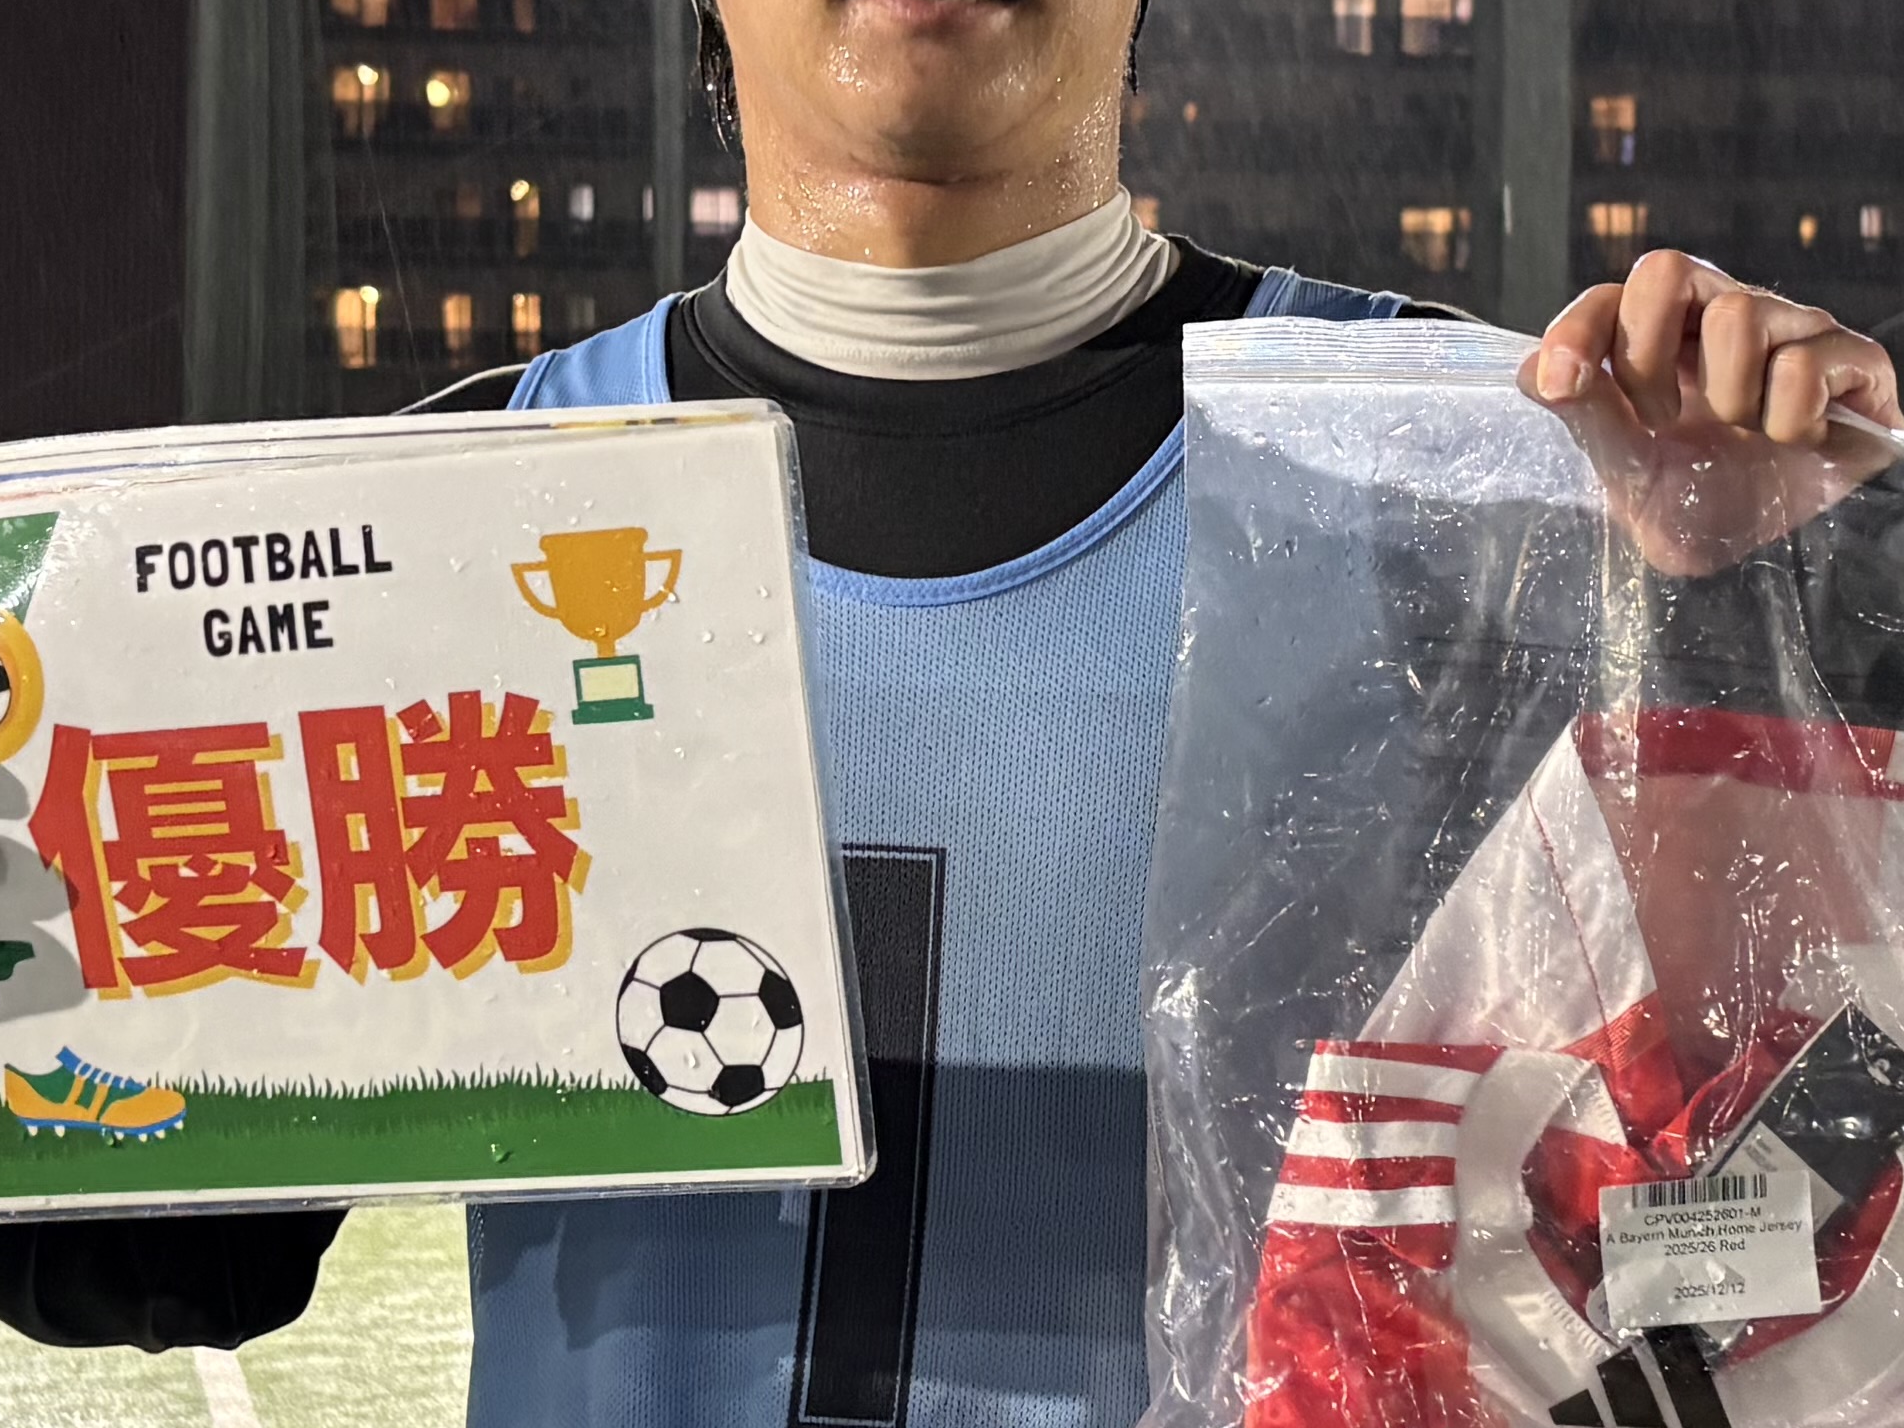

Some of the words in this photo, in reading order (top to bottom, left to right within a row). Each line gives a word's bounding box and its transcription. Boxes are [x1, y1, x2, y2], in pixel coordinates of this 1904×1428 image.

[135, 524, 393, 593] FOOTBALL
[203, 600, 334, 657] GAME
[27, 689, 592, 1000] 優勝
[1606, 1233, 1616, 1245] A
[1619, 1231, 1665, 1245] Bayern
[1718, 1224, 1756, 1237] Home
[1759, 1219, 1803, 1234] Jersey
[1664, 1241, 1717, 1257] 2025/26
[1720, 1237, 1746, 1252] Red
[1673, 1282, 1746, 1300] 2025/12/12
